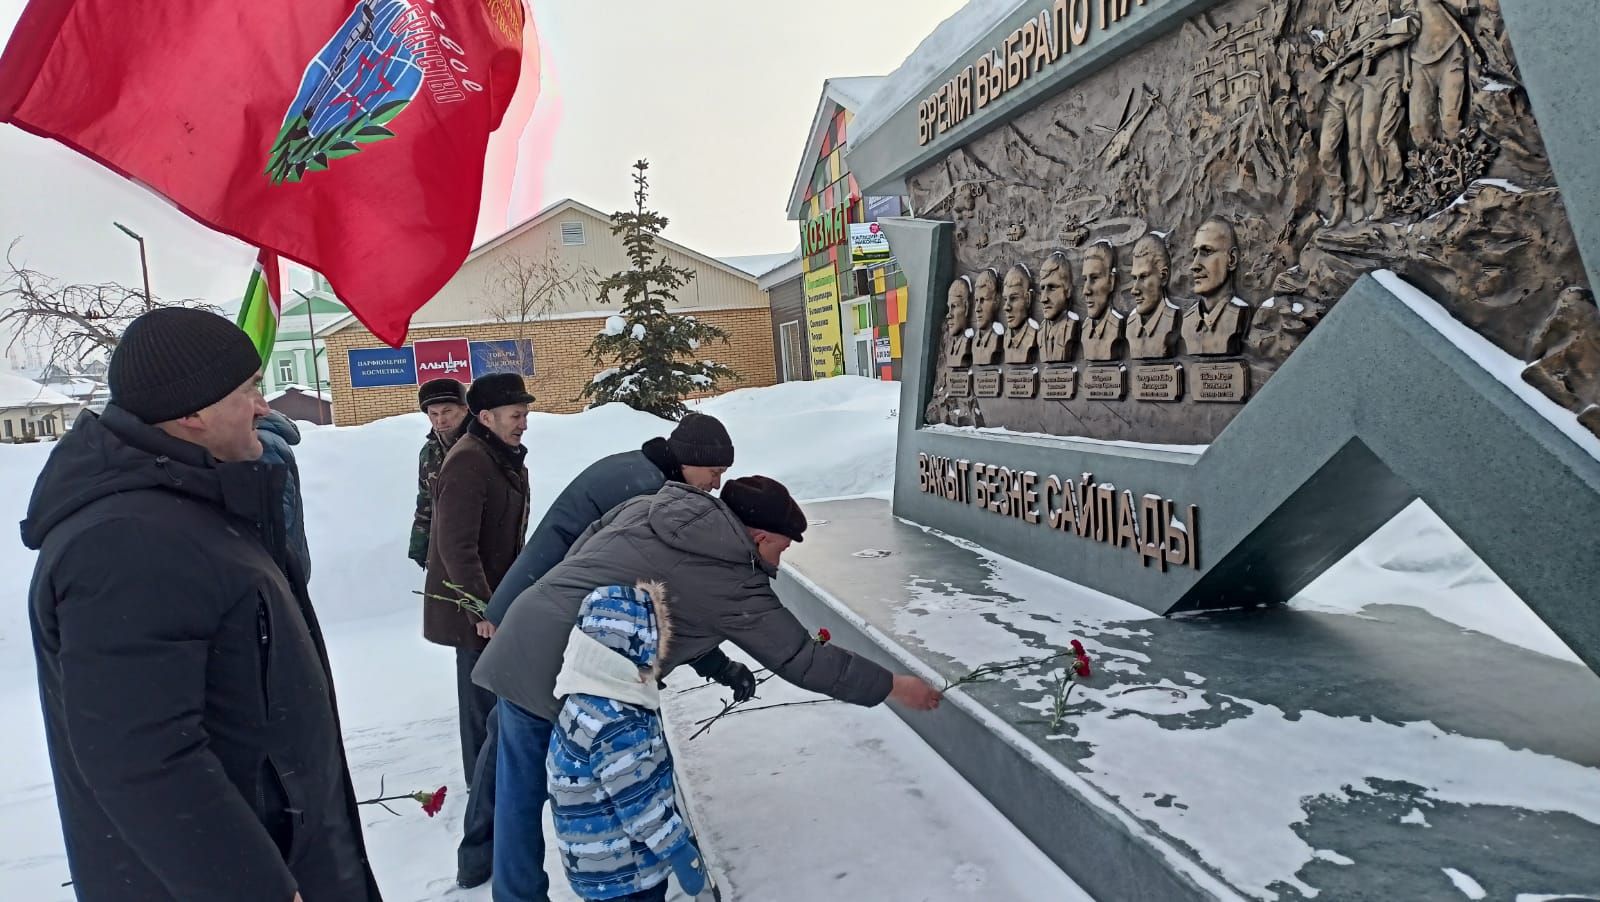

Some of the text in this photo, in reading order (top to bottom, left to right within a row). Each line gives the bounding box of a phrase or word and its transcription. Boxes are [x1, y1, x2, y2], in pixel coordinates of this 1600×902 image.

[389, 3, 466, 104] БРАТСТВО
[918, 0, 1088, 146] ВРЕМЯ ВЫБРАЛО
[357, 358, 407, 367] ПАРФЮМЕРИЯ
[362, 368, 404, 376] КОСМЕТИКА
[419, 352, 467, 374] АЛЬПАРИ
[918, 452, 1200, 573] ВАКЫТ БЕЗНЕ САЙЛАДЫ
